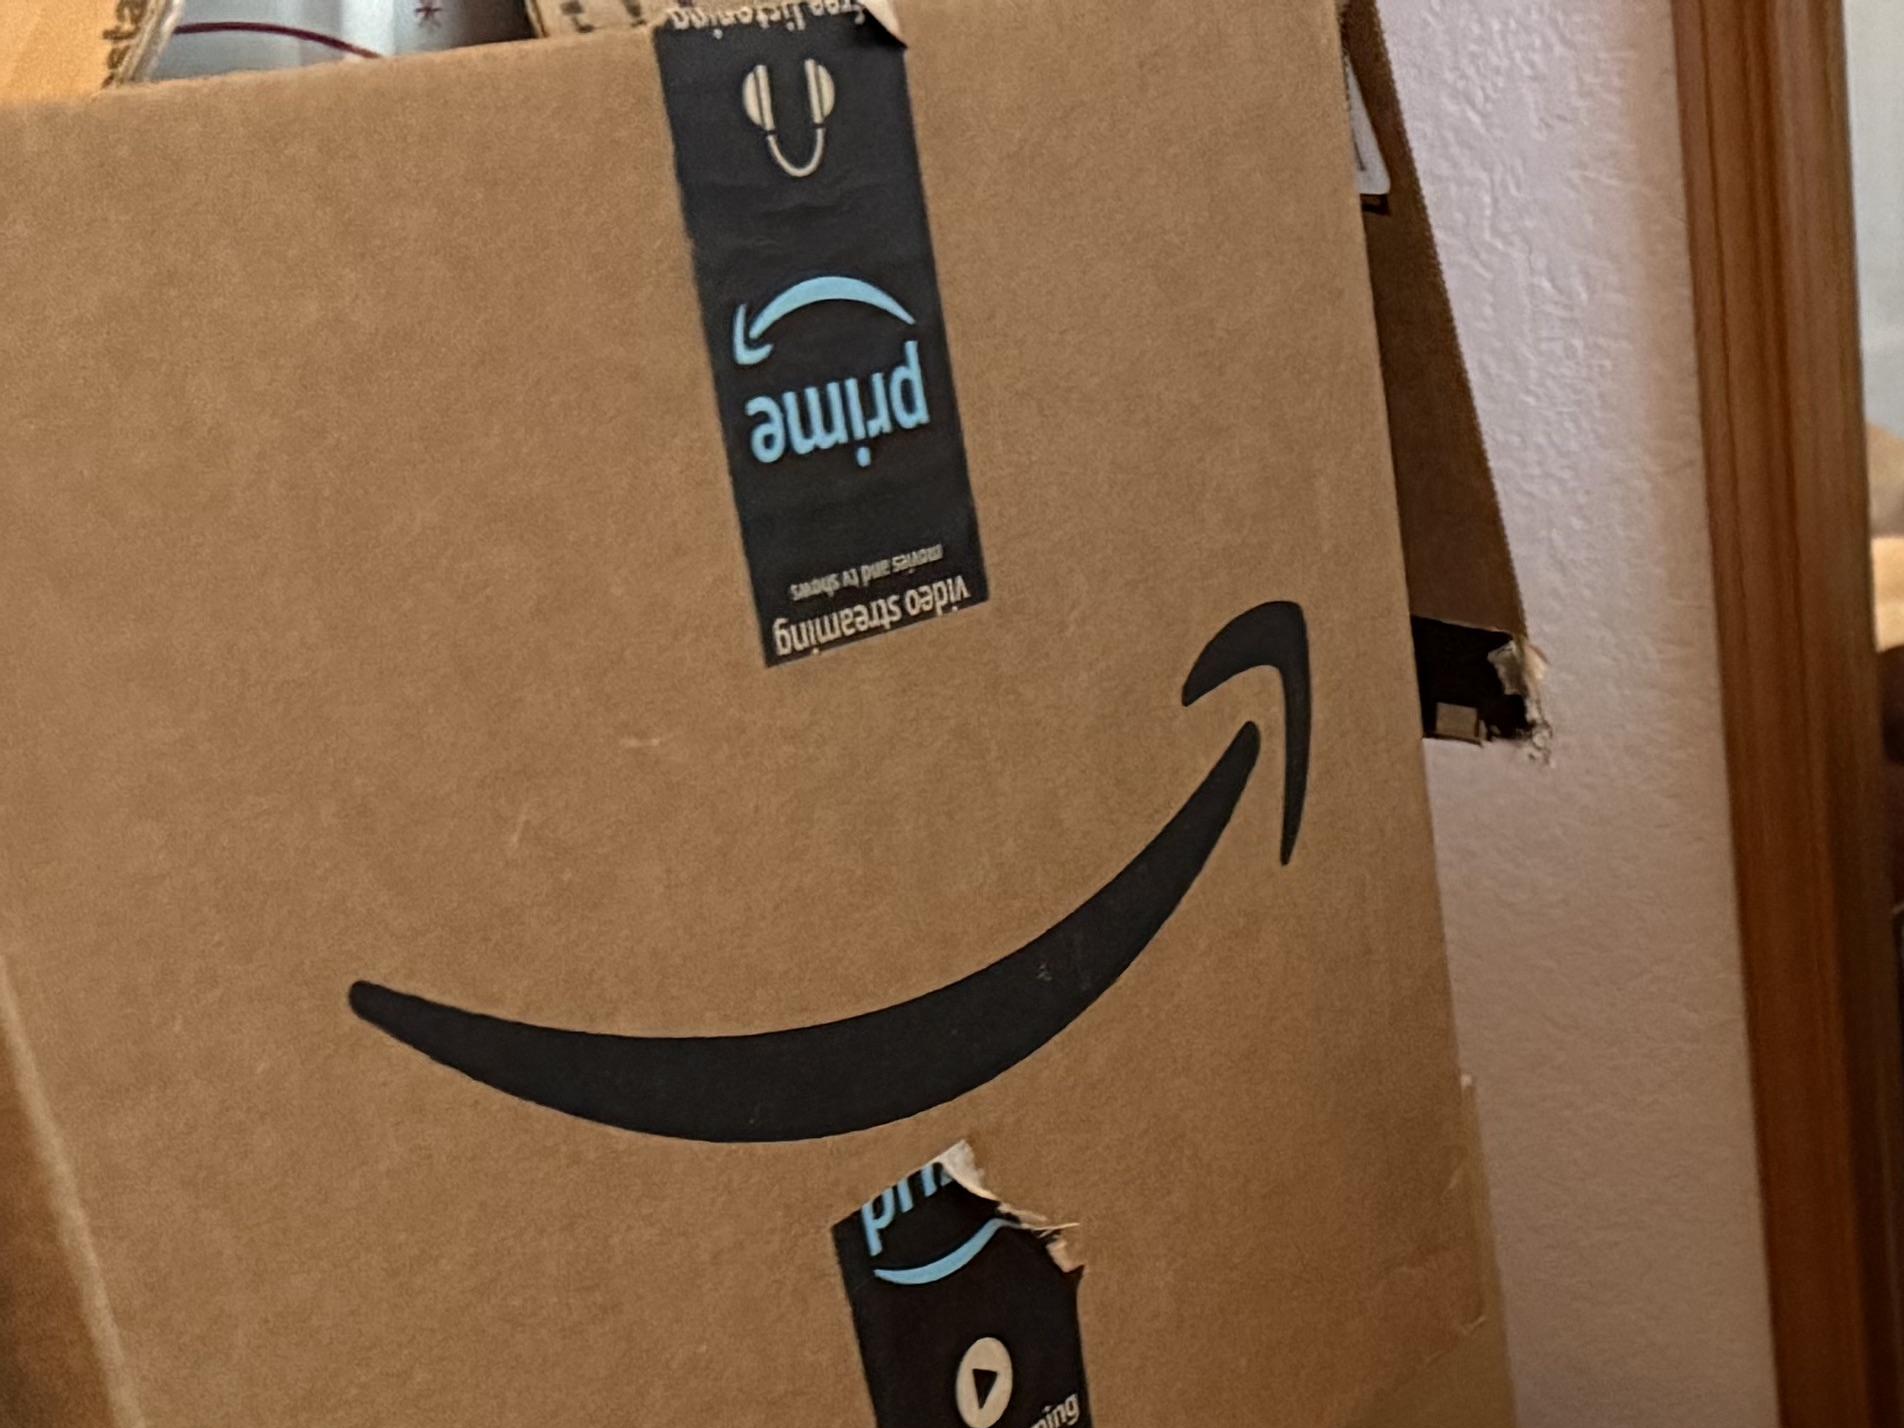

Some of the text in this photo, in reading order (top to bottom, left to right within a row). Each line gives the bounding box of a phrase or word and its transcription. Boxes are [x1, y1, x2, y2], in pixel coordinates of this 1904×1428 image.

[745, 340, 931, 468] prime
[860, 562, 891, 588] and
[893, 543, 944, 577] movies
[789, 574, 840, 602] shows
[773, 574, 971, 656] video streaming
